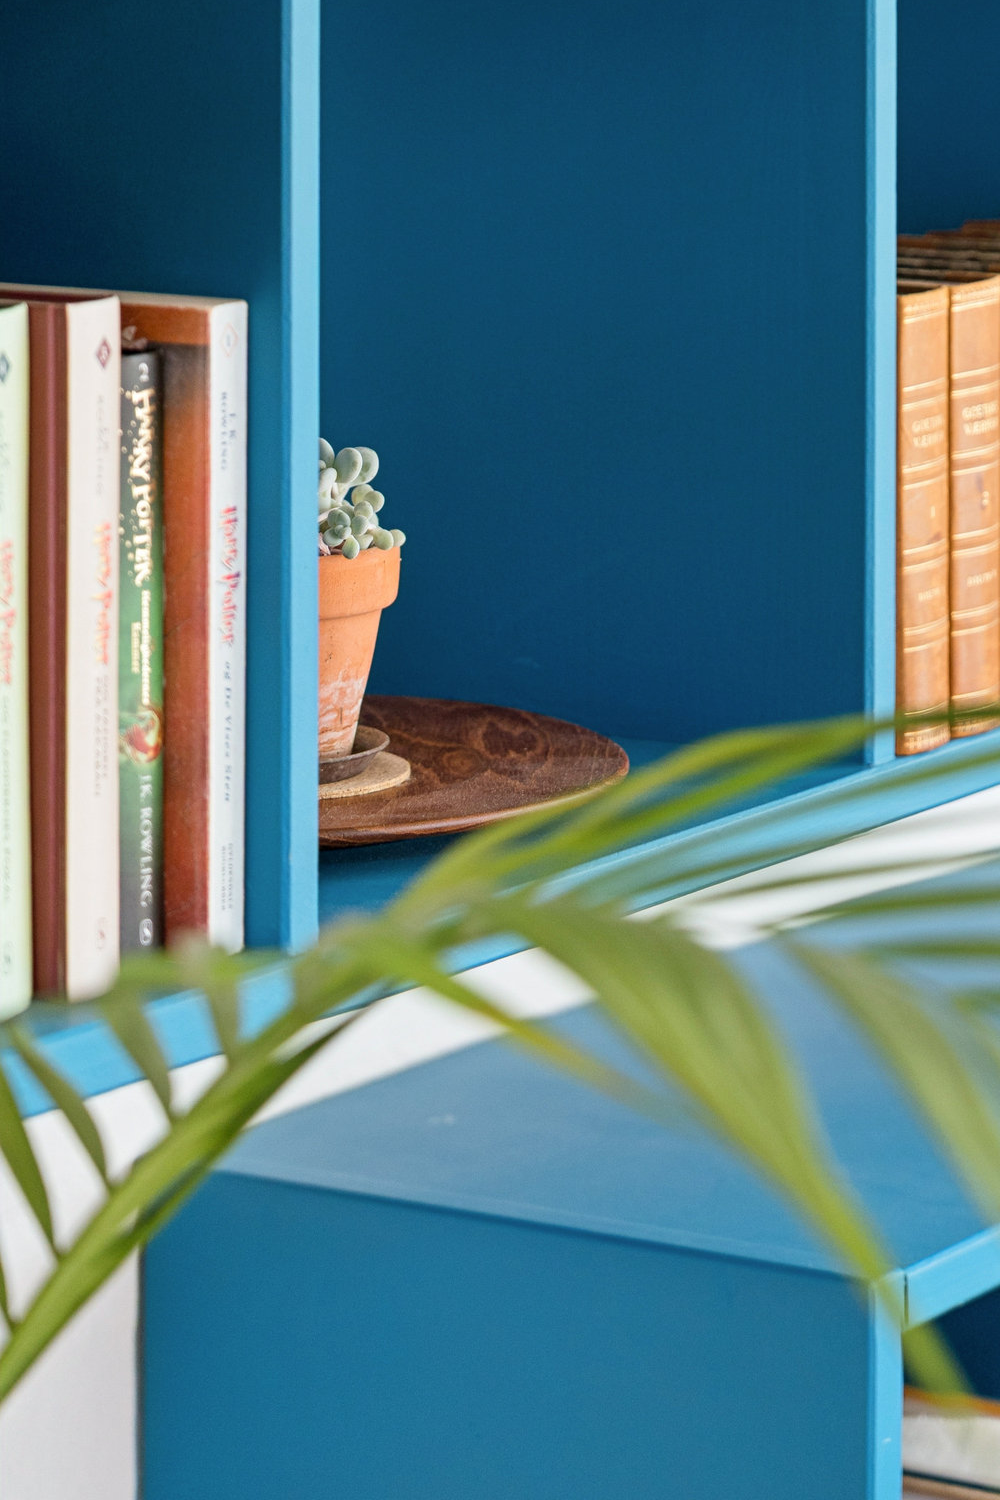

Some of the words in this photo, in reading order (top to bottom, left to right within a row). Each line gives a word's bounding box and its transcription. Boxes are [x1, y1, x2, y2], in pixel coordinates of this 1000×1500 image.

[130, 388, 156, 481] HARRY
[131, 484, 157, 588] POTTER
[140, 806, 153, 907] ROWLING
